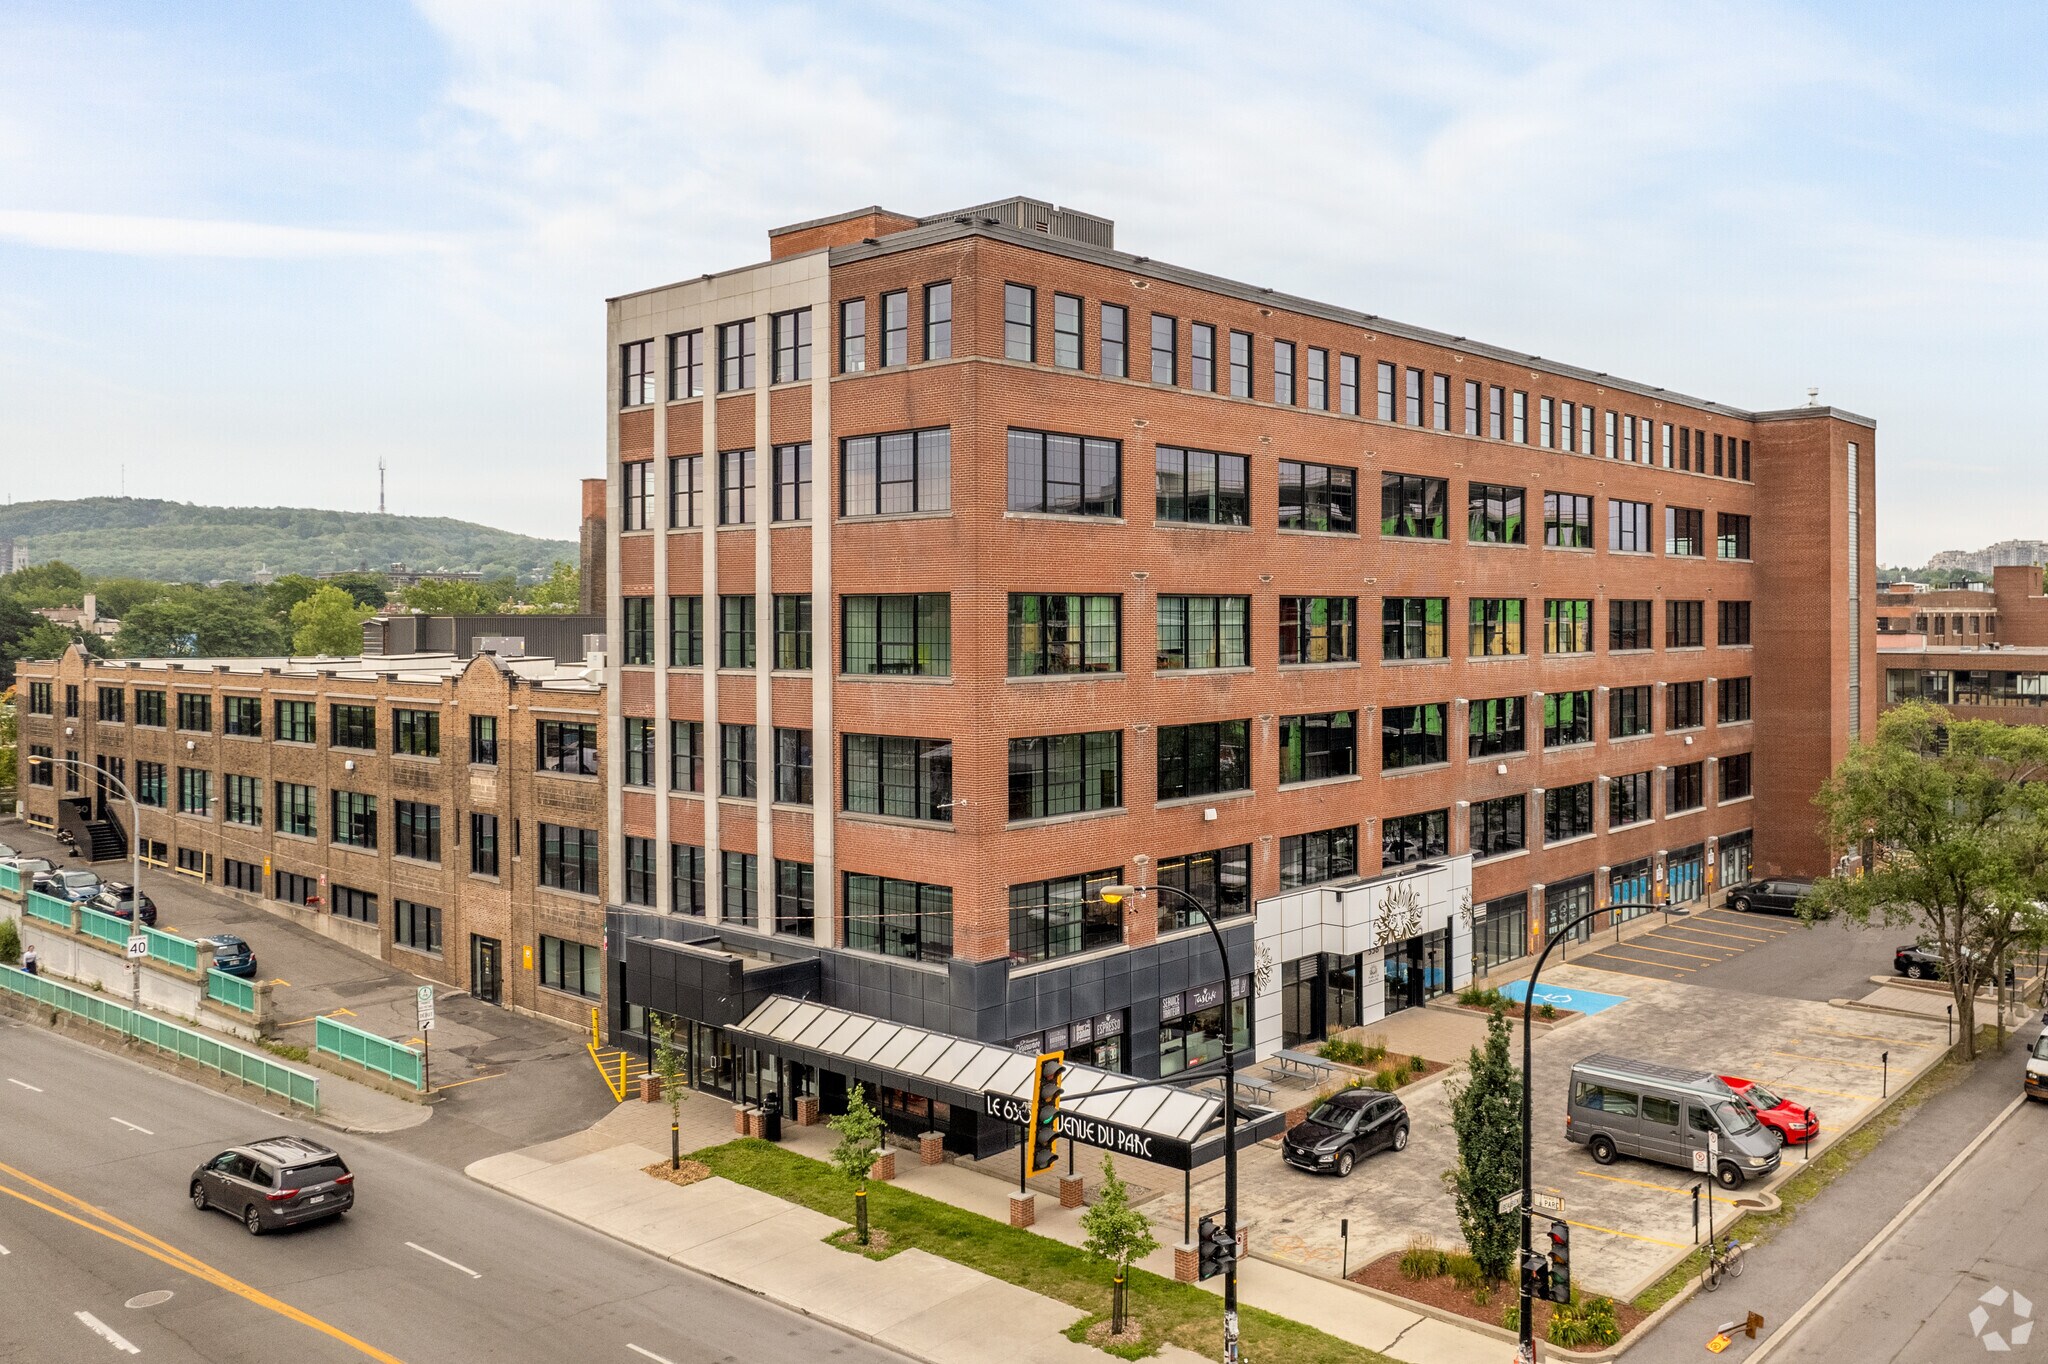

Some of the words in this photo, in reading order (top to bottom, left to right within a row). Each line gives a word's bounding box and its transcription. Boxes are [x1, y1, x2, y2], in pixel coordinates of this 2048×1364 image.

[130, 941, 146, 954] 40
[1096, 1018, 1121, 1036] ESPRESSO
[987, 1095, 1001, 1117] LE
[1056, 1113, 1095, 1142] VENUE
[1098, 1123, 1114, 1147] DU
[1117, 1129, 1152, 1157] PARC
